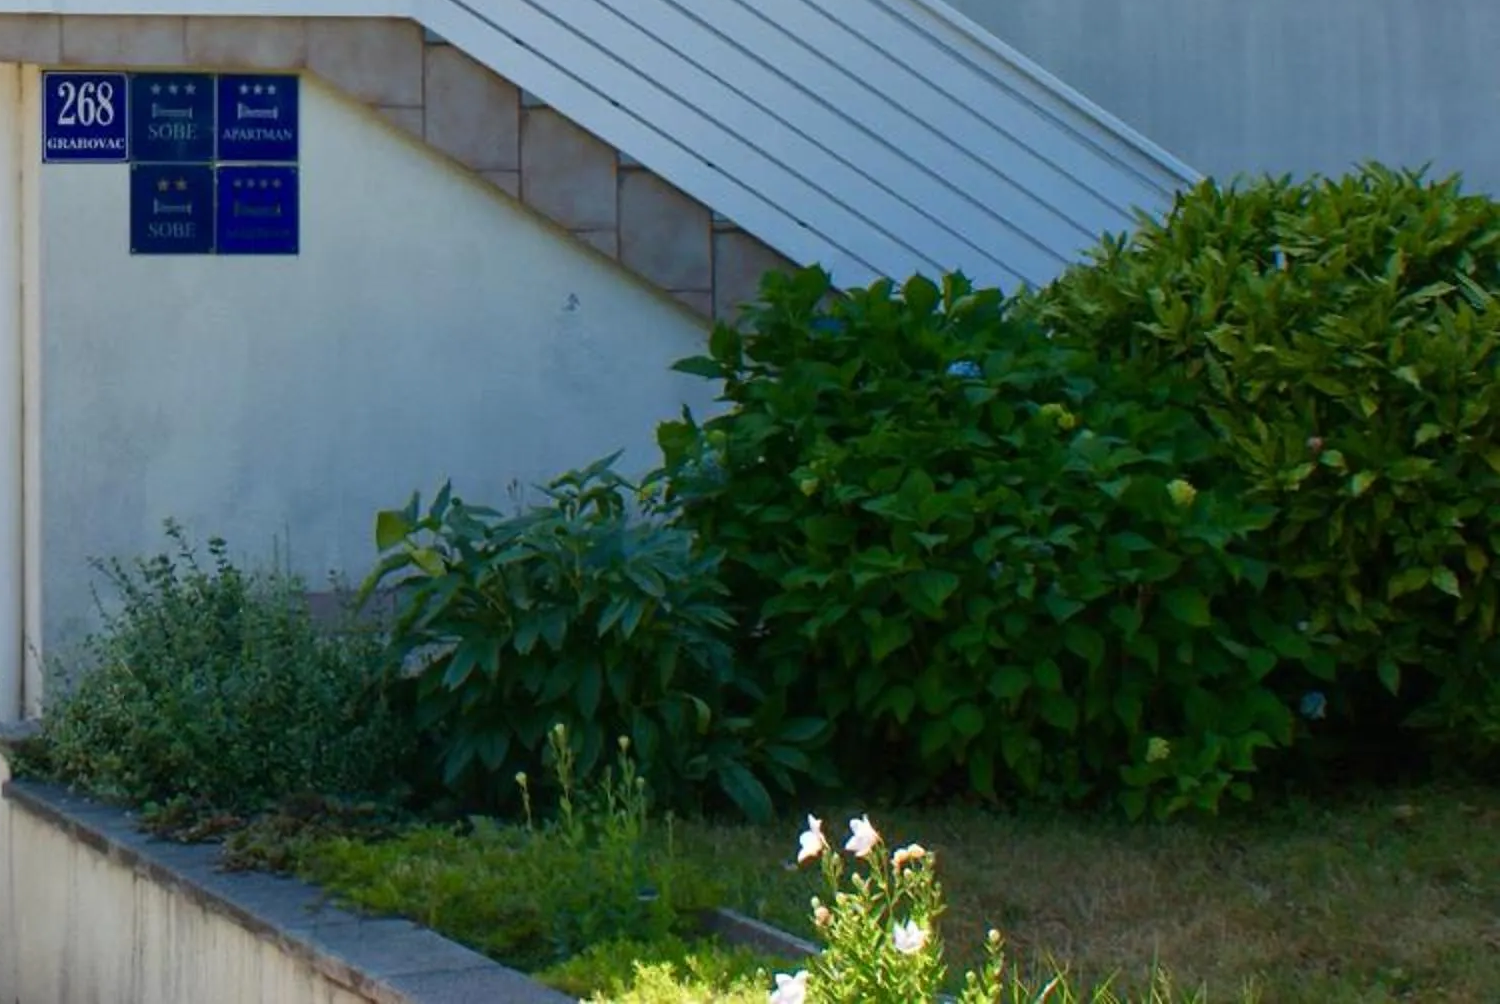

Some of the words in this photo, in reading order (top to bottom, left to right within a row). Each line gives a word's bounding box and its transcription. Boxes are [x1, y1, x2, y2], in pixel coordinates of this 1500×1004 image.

[58, 81, 115, 127] 268
[148, 123, 197, 141] SOBE
[222, 128, 293, 141] APARTMAN
[147, 222, 196, 239] SOBE
